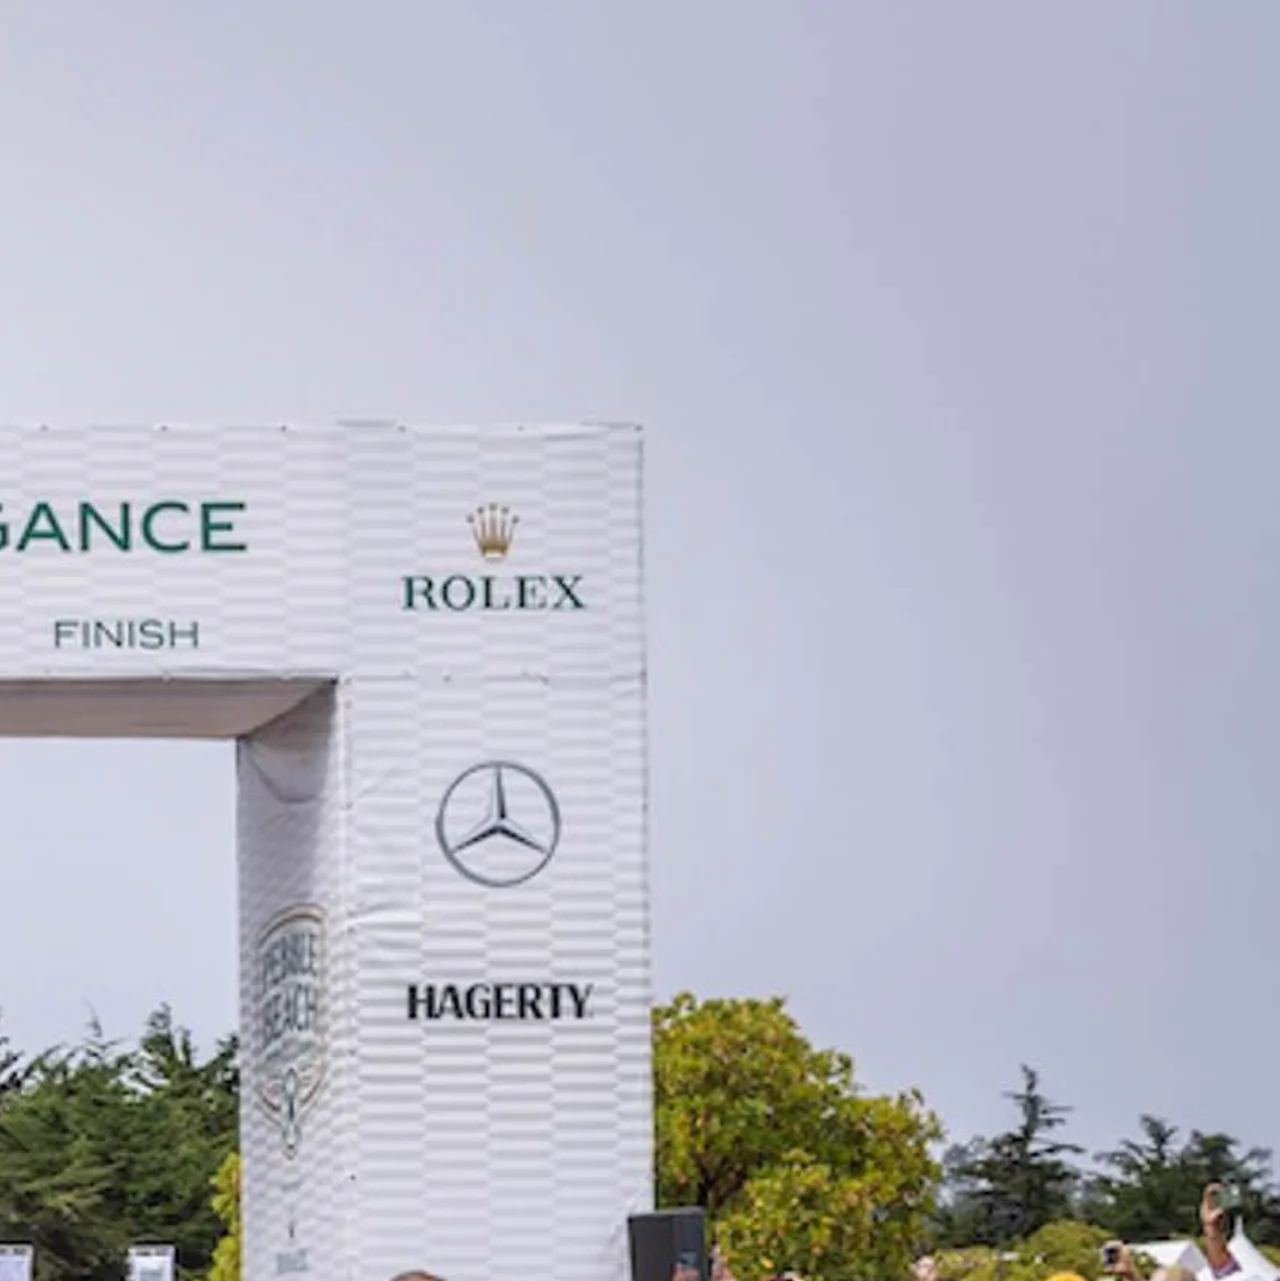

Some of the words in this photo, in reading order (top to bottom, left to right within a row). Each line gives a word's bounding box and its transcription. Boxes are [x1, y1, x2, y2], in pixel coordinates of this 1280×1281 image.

[403, 575, 586, 611] ROLEX
[54, 618, 199, 650] FINISH
[406, 983, 592, 1020] HAGERTY
